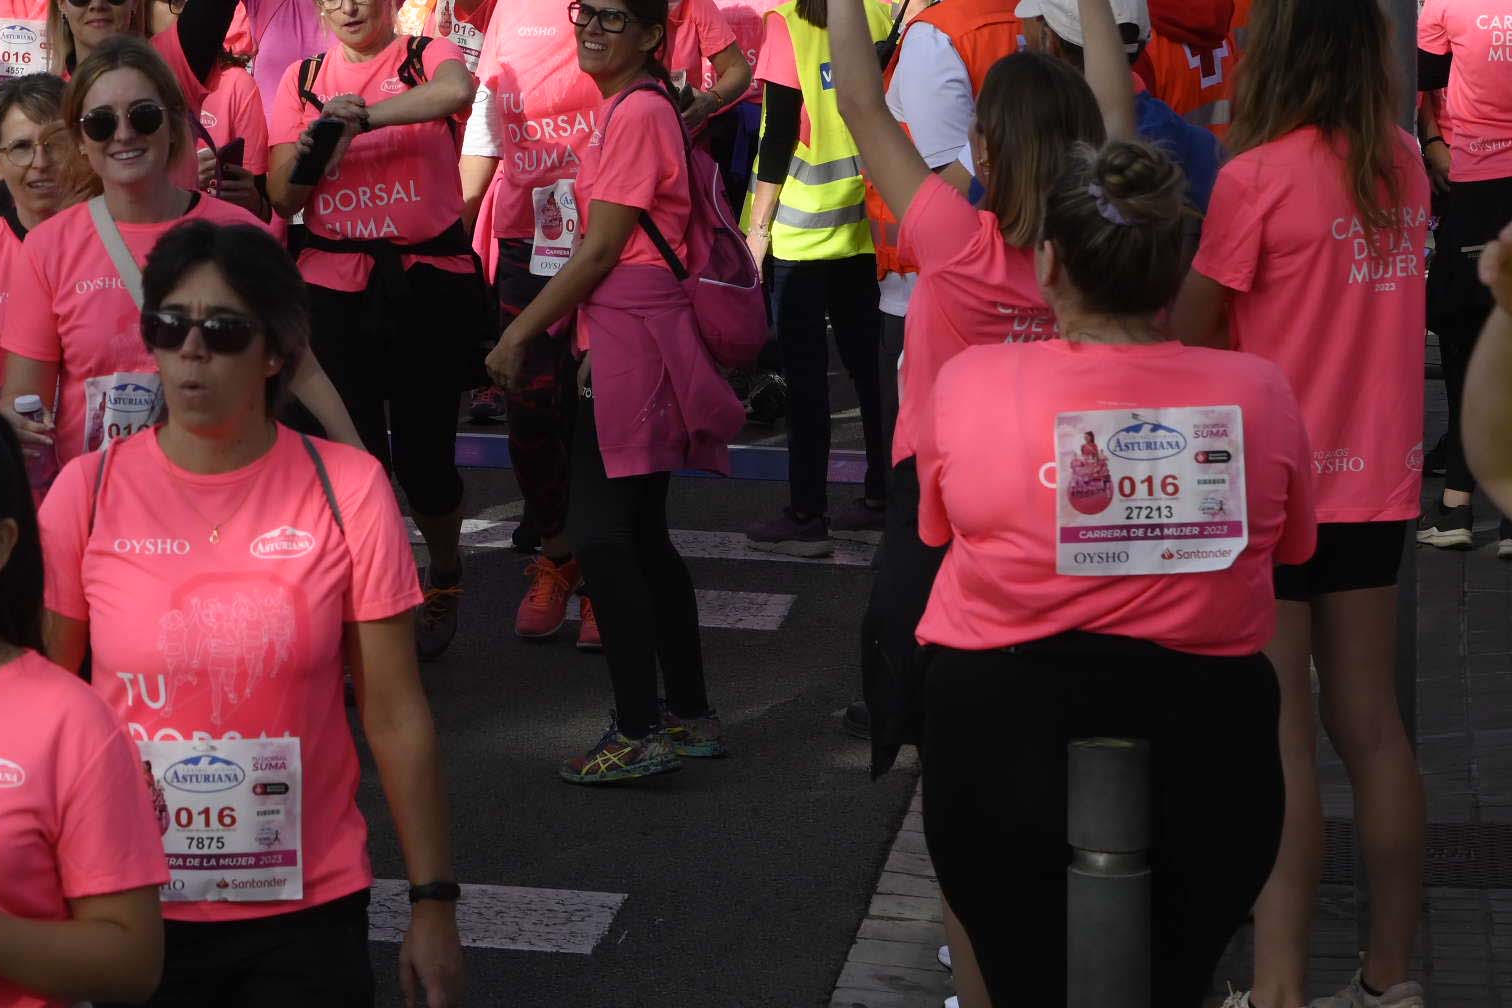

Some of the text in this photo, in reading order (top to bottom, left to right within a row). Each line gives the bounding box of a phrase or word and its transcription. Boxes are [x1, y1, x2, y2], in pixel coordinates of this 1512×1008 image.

[453, 22, 476, 38] 016
[2, 50, 32, 64] 016
[501, 92, 524, 114] TU
[514, 144, 582, 173] SUMA
[318, 179, 421, 216] DORSAL
[566, 218, 575, 233] 0
[1348, 255, 1419, 283] MUJER
[1193, 429, 1229, 439] SUMA
[1114, 438, 1181, 453] ASTURIANA
[1118, 474, 1181, 498] 016
[1125, 505, 1174, 520] 27213
[1079, 525, 1228, 539] CARRERA DE LA MUJER 2023
[115, 537, 190, 556] OYSHO
[255, 539, 315, 555] ASTURIANA
[1074, 548, 1232, 565] OYSHO Santander
[118, 672, 167, 709] TU
[252, 761, 288, 772] SUMA
[171, 769, 239, 784] ASTURIANA
[174, 805, 238, 829] 016
[186, 836, 226, 850] 7875
[186, 856, 201, 866] DE
[202, 856, 217, 866] LA
[219, 856, 256, 866] MUJER
[231, 876, 288, 890] Santander
